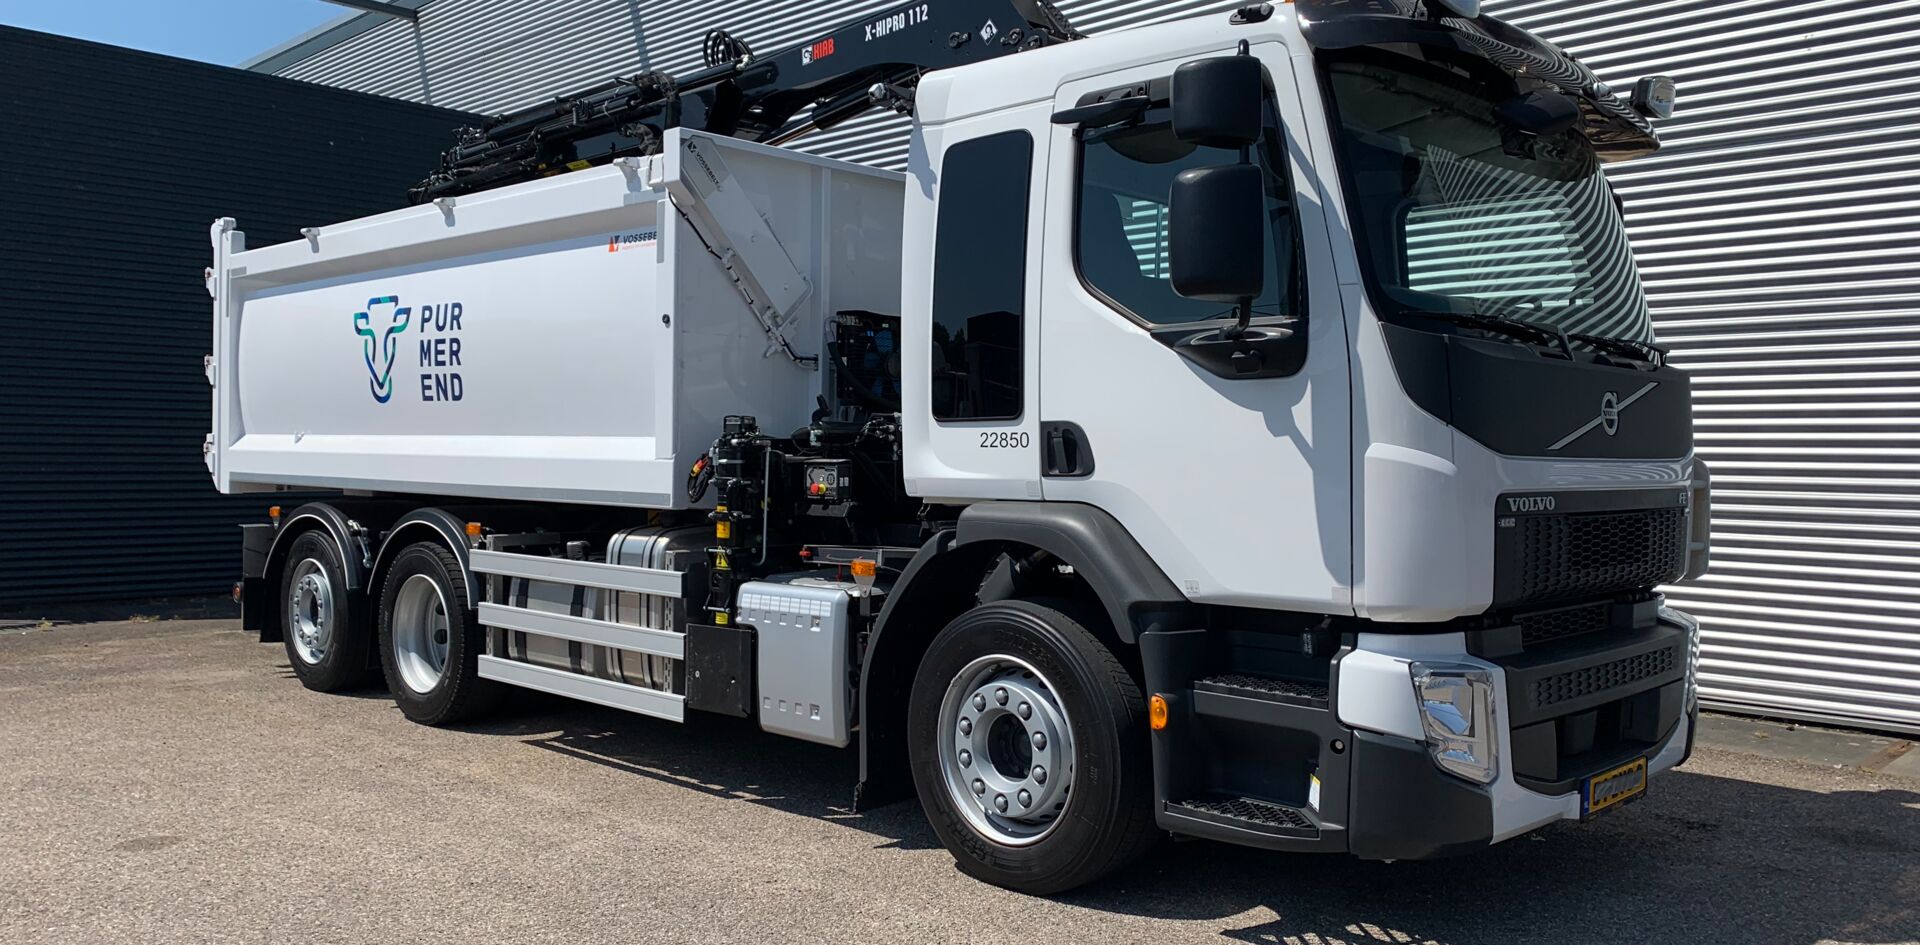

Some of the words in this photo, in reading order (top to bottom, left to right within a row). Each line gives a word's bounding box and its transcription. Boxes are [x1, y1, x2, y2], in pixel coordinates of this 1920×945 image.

[865, 12, 905, 42] X-HIPRO
[908, 4, 929, 26] 112
[813, 38, 834, 60] HIAB
[420, 302, 463, 333] PUR
[419, 337, 462, 368] MER
[420, 373, 464, 402] END
[980, 432, 1030, 448] 22850
[1506, 496, 1556, 512] VOLVO
